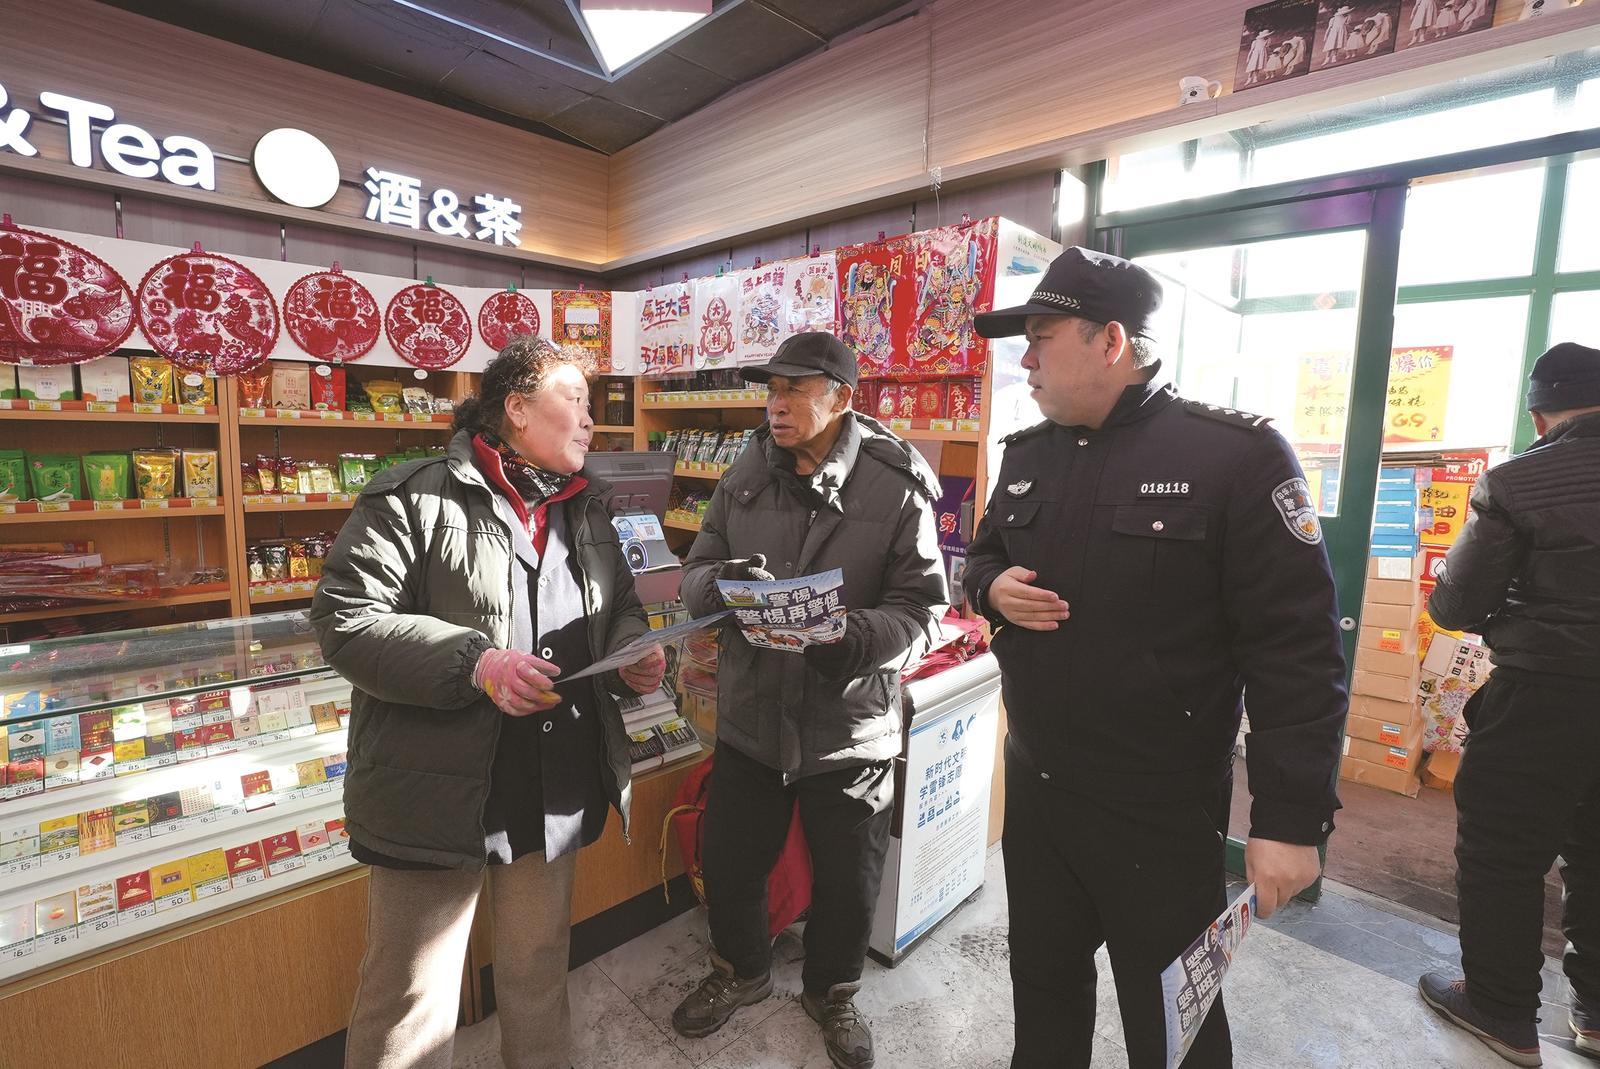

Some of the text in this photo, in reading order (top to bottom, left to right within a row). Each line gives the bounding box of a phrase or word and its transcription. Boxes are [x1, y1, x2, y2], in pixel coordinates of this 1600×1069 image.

[40, 92, 215, 191] Tea
[364, 166, 522, 248] 酒&茶
[162, 260, 221, 312] 福
[314, 278, 357, 319] 福
[411, 289, 446, 325] 福
[1140, 482, 1190, 494] 018118
[735, 590, 839, 624] 警惕再警惕
[768, 588, 811, 607] 警惕
[134, 909, 148, 918] 50
[171, 897, 184, 906] 50
[95, 921, 109, 931] 20
[53, 935, 67, 945] 26
